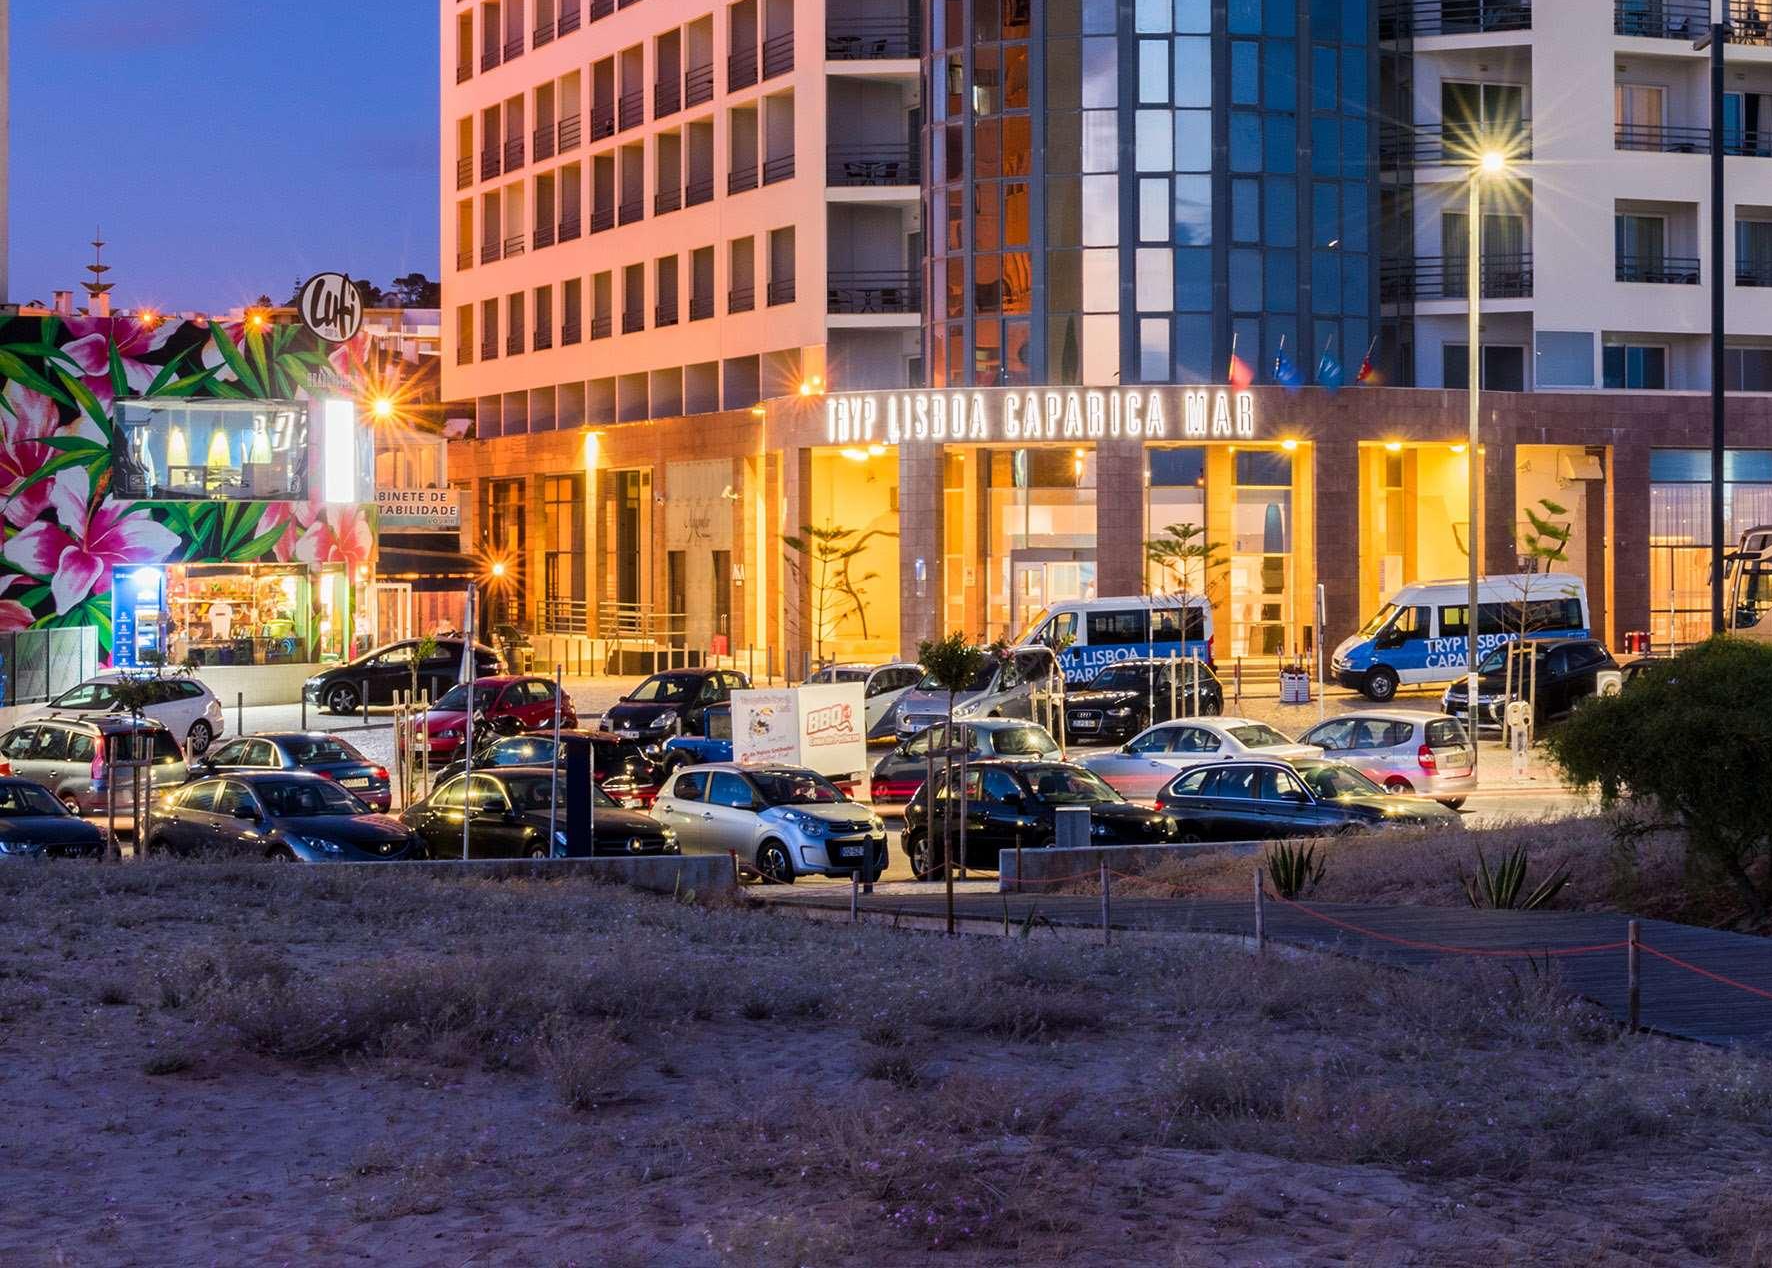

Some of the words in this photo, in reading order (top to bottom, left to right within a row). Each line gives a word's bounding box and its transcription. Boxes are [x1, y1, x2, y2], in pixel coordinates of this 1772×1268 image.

[827, 396, 876, 443] TRYP
[888, 394, 986, 443] LISBOA
[1005, 390, 1164, 438] CAPARICA
[1186, 390, 1253, 438] MAR
[430, 492, 447, 502] DE
[379, 505, 457, 516] TABILIDADE
[1424, 636, 1463, 654] TRYP
[1464, 633, 1518, 651] LSBOA
[1083, 647, 1139, 666] LISBOA
